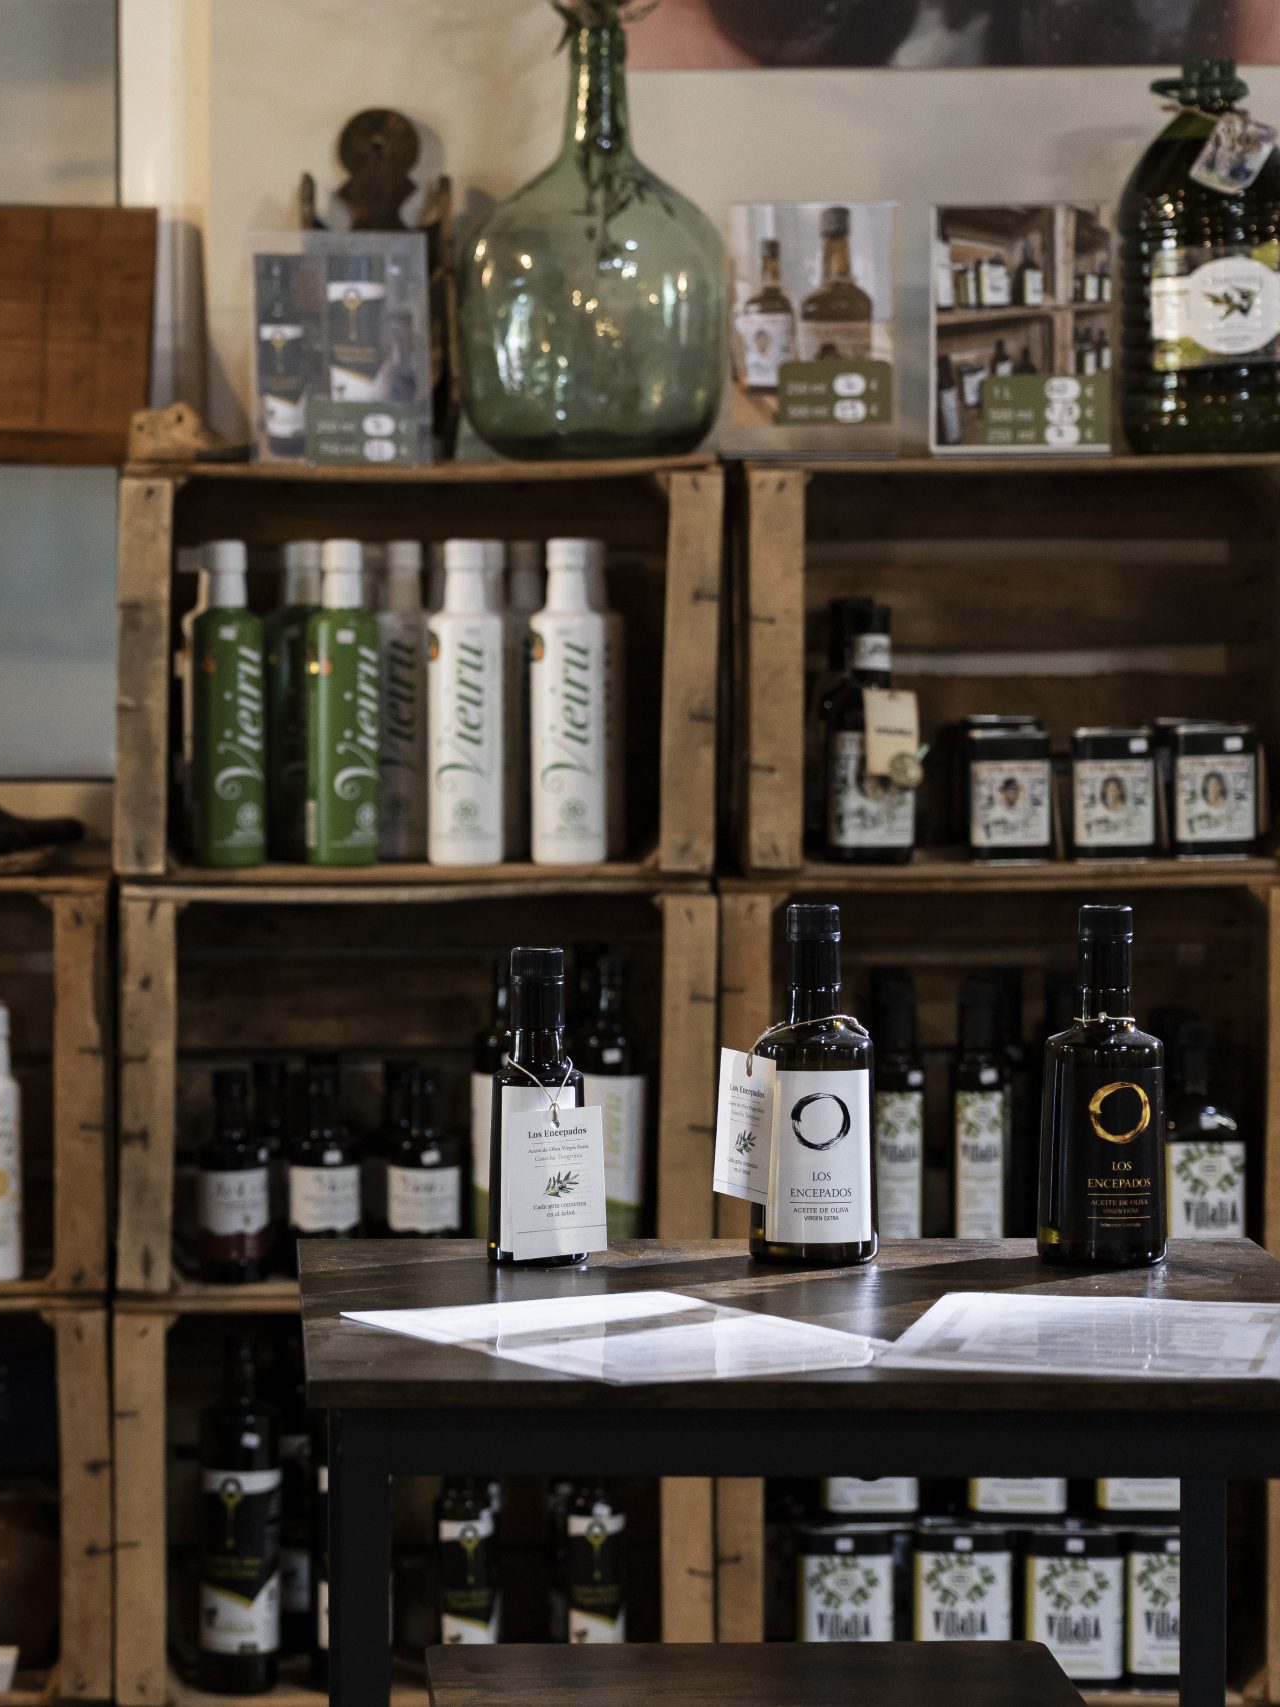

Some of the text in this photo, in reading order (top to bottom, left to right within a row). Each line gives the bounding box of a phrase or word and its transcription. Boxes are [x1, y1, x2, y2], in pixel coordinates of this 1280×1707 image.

[214, 644, 265, 801] Vieiru
[434, 641, 489, 795] Vieiru
[540, 640, 597, 794] Vieiru
[528, 1126, 587, 1139] Los Encepados
[1112, 1161, 1132, 1171] LOS
[812, 1171, 832, 1182] LOS
[1087, 1177, 1151, 1189] ENCEPADOS
[790, 1187, 852, 1198] ENCEPADOS
[1129, 1198, 1149, 1206] OLIVA
